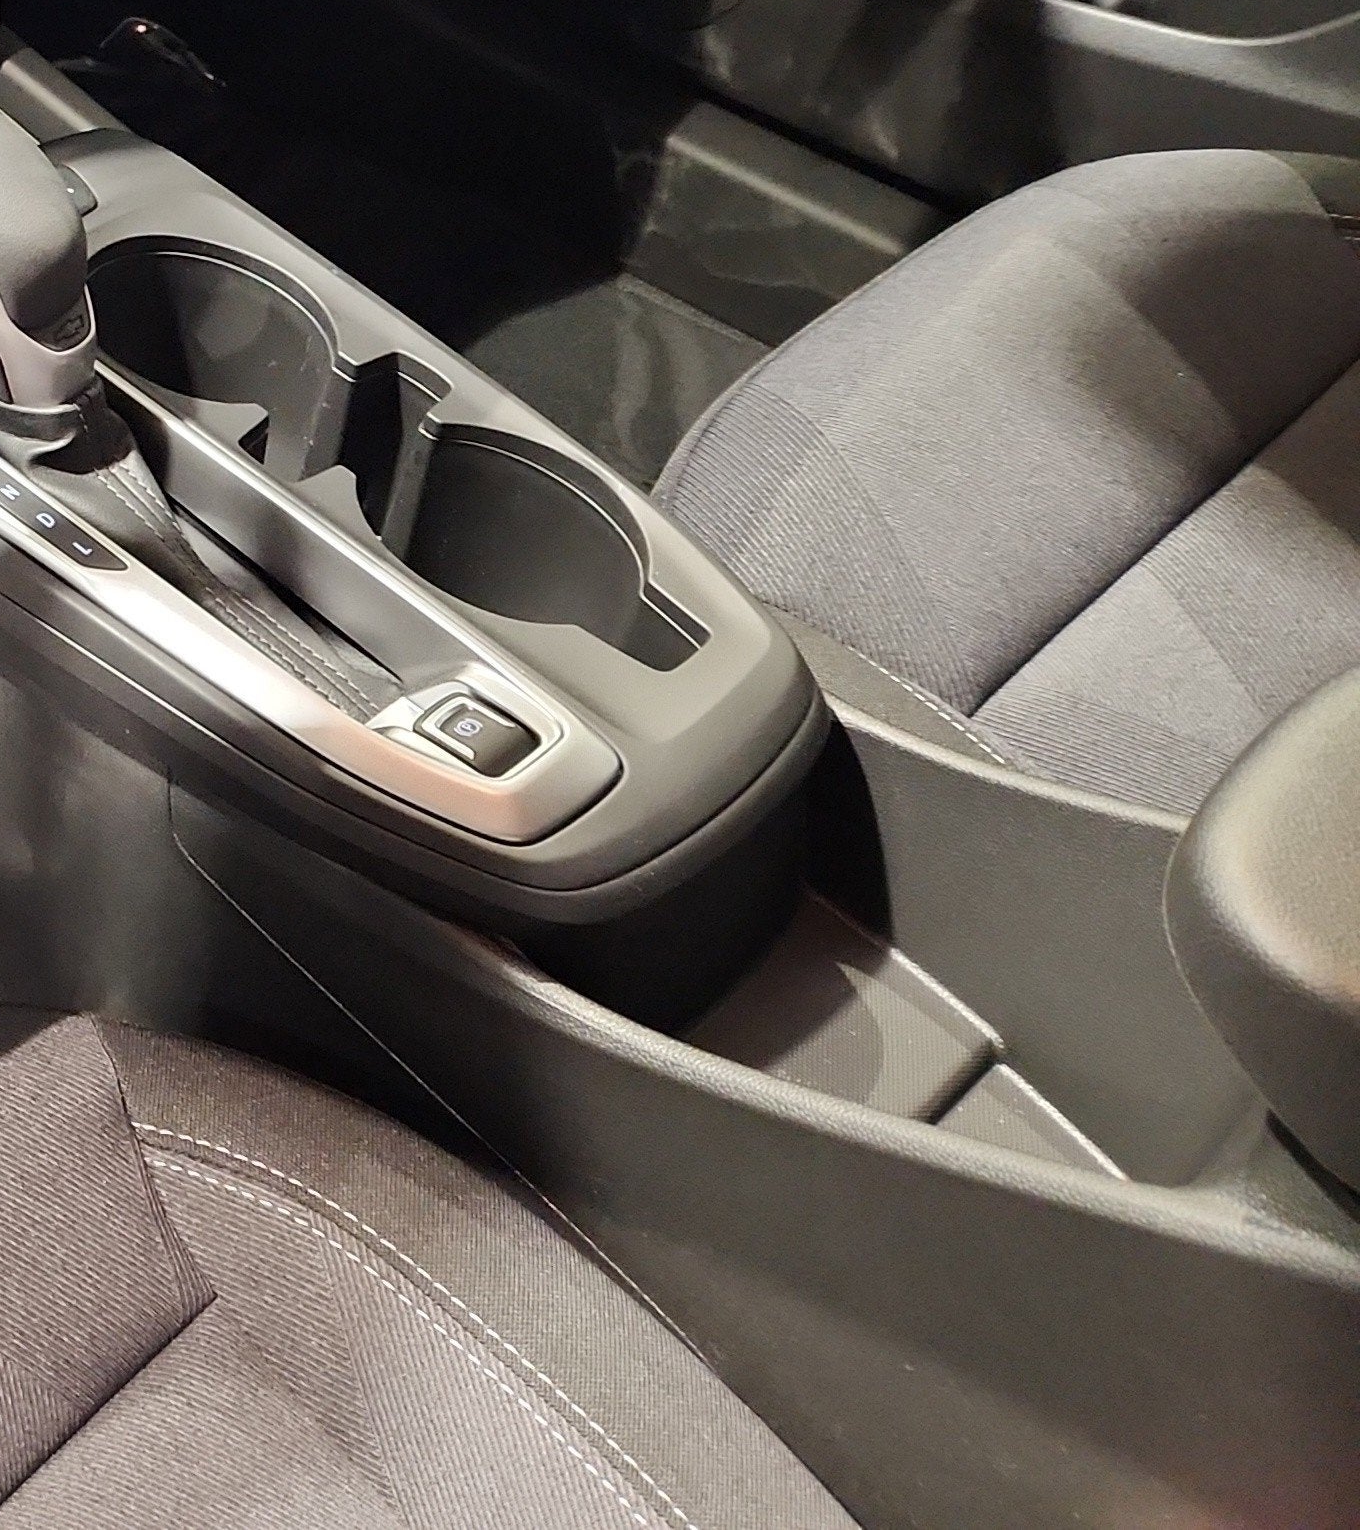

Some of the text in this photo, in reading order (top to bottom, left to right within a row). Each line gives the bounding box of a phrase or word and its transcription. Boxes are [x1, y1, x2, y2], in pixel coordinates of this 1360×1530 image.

[0, 483, 21, 501] N
[35, 511, 57, 530] D
[71, 541, 94, 557] L
